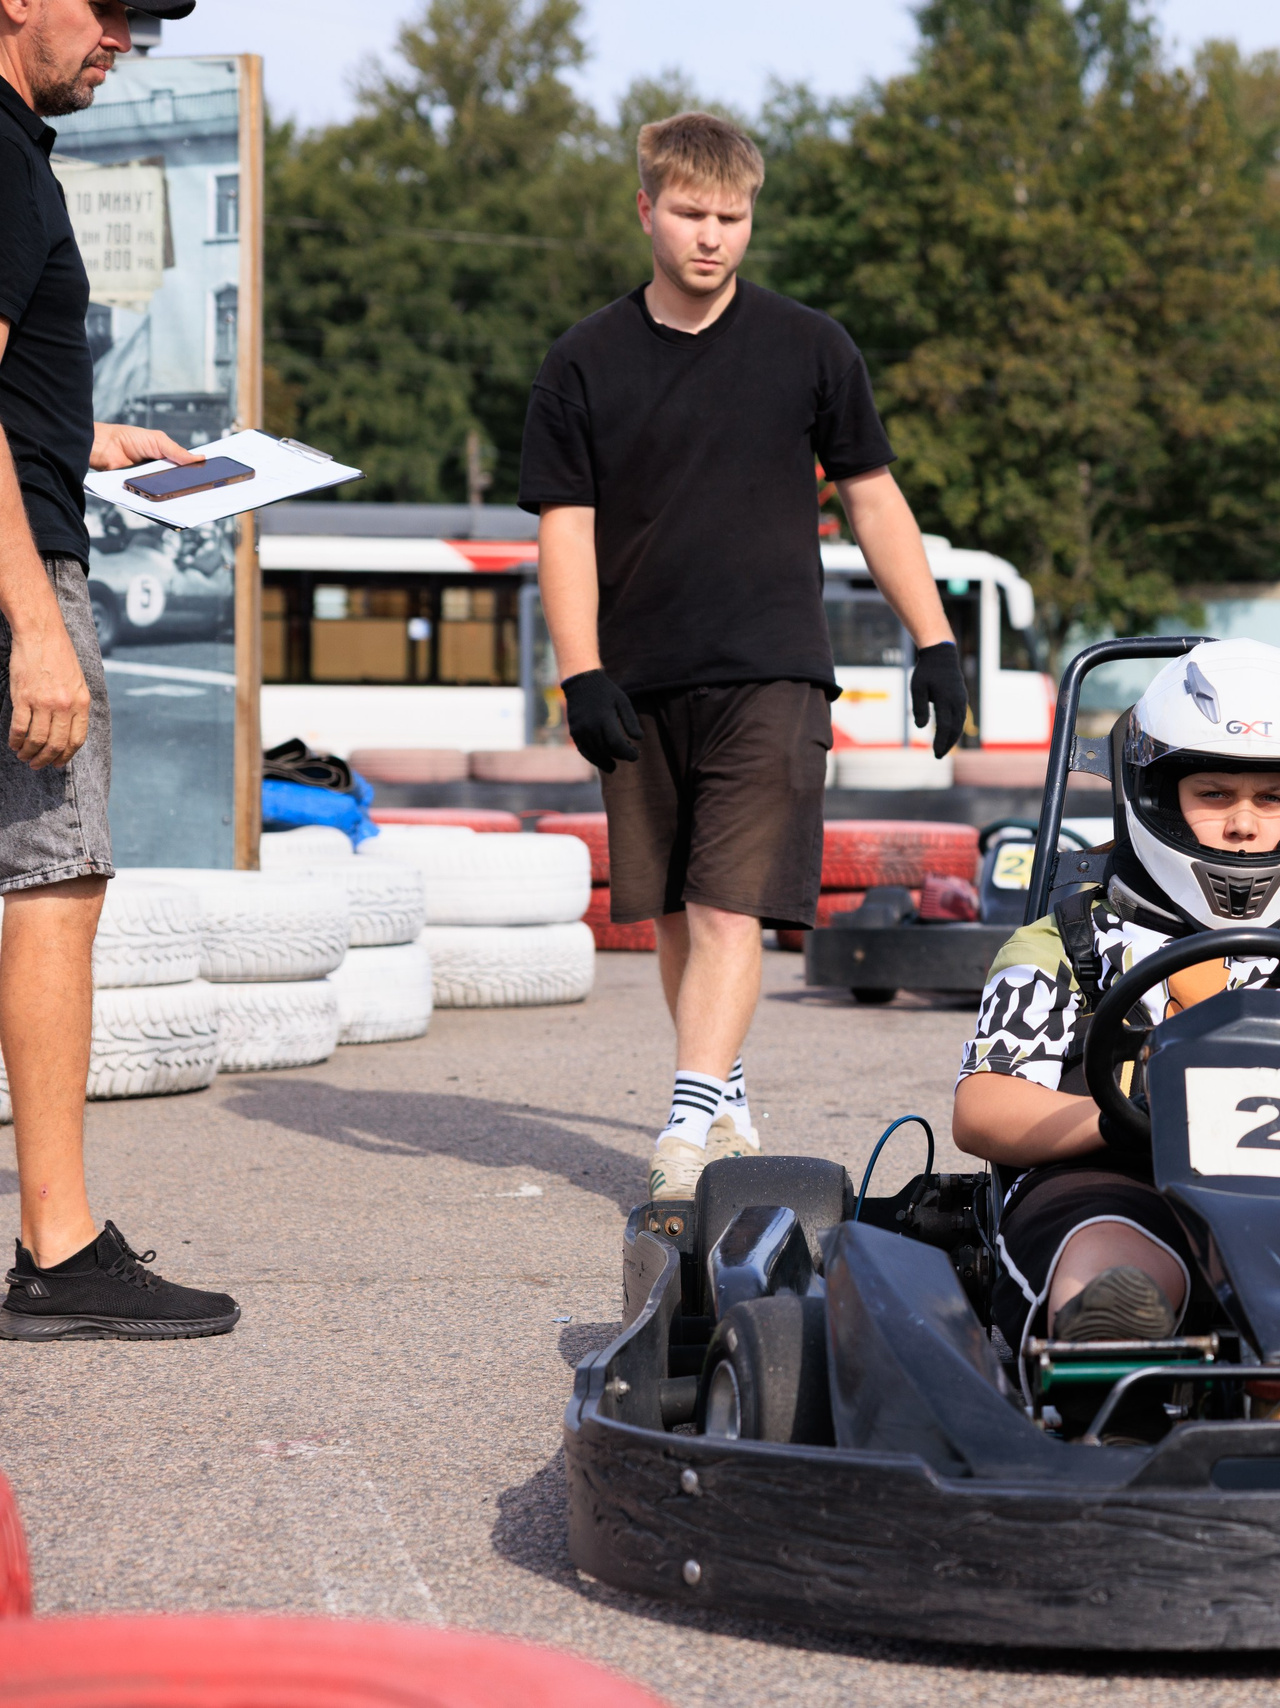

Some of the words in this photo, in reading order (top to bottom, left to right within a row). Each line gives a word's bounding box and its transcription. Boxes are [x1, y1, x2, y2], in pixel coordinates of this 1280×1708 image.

[76, 191, 92, 214] 10
[98, 190, 154, 213] МИНУТ
[106, 222, 132, 245] 700
[104, 248, 132, 272] 800
[140, 579, 152, 609] 5
[1226, 720, 1273, 738] GXT
[1002, 855, 1026, 876] 2
